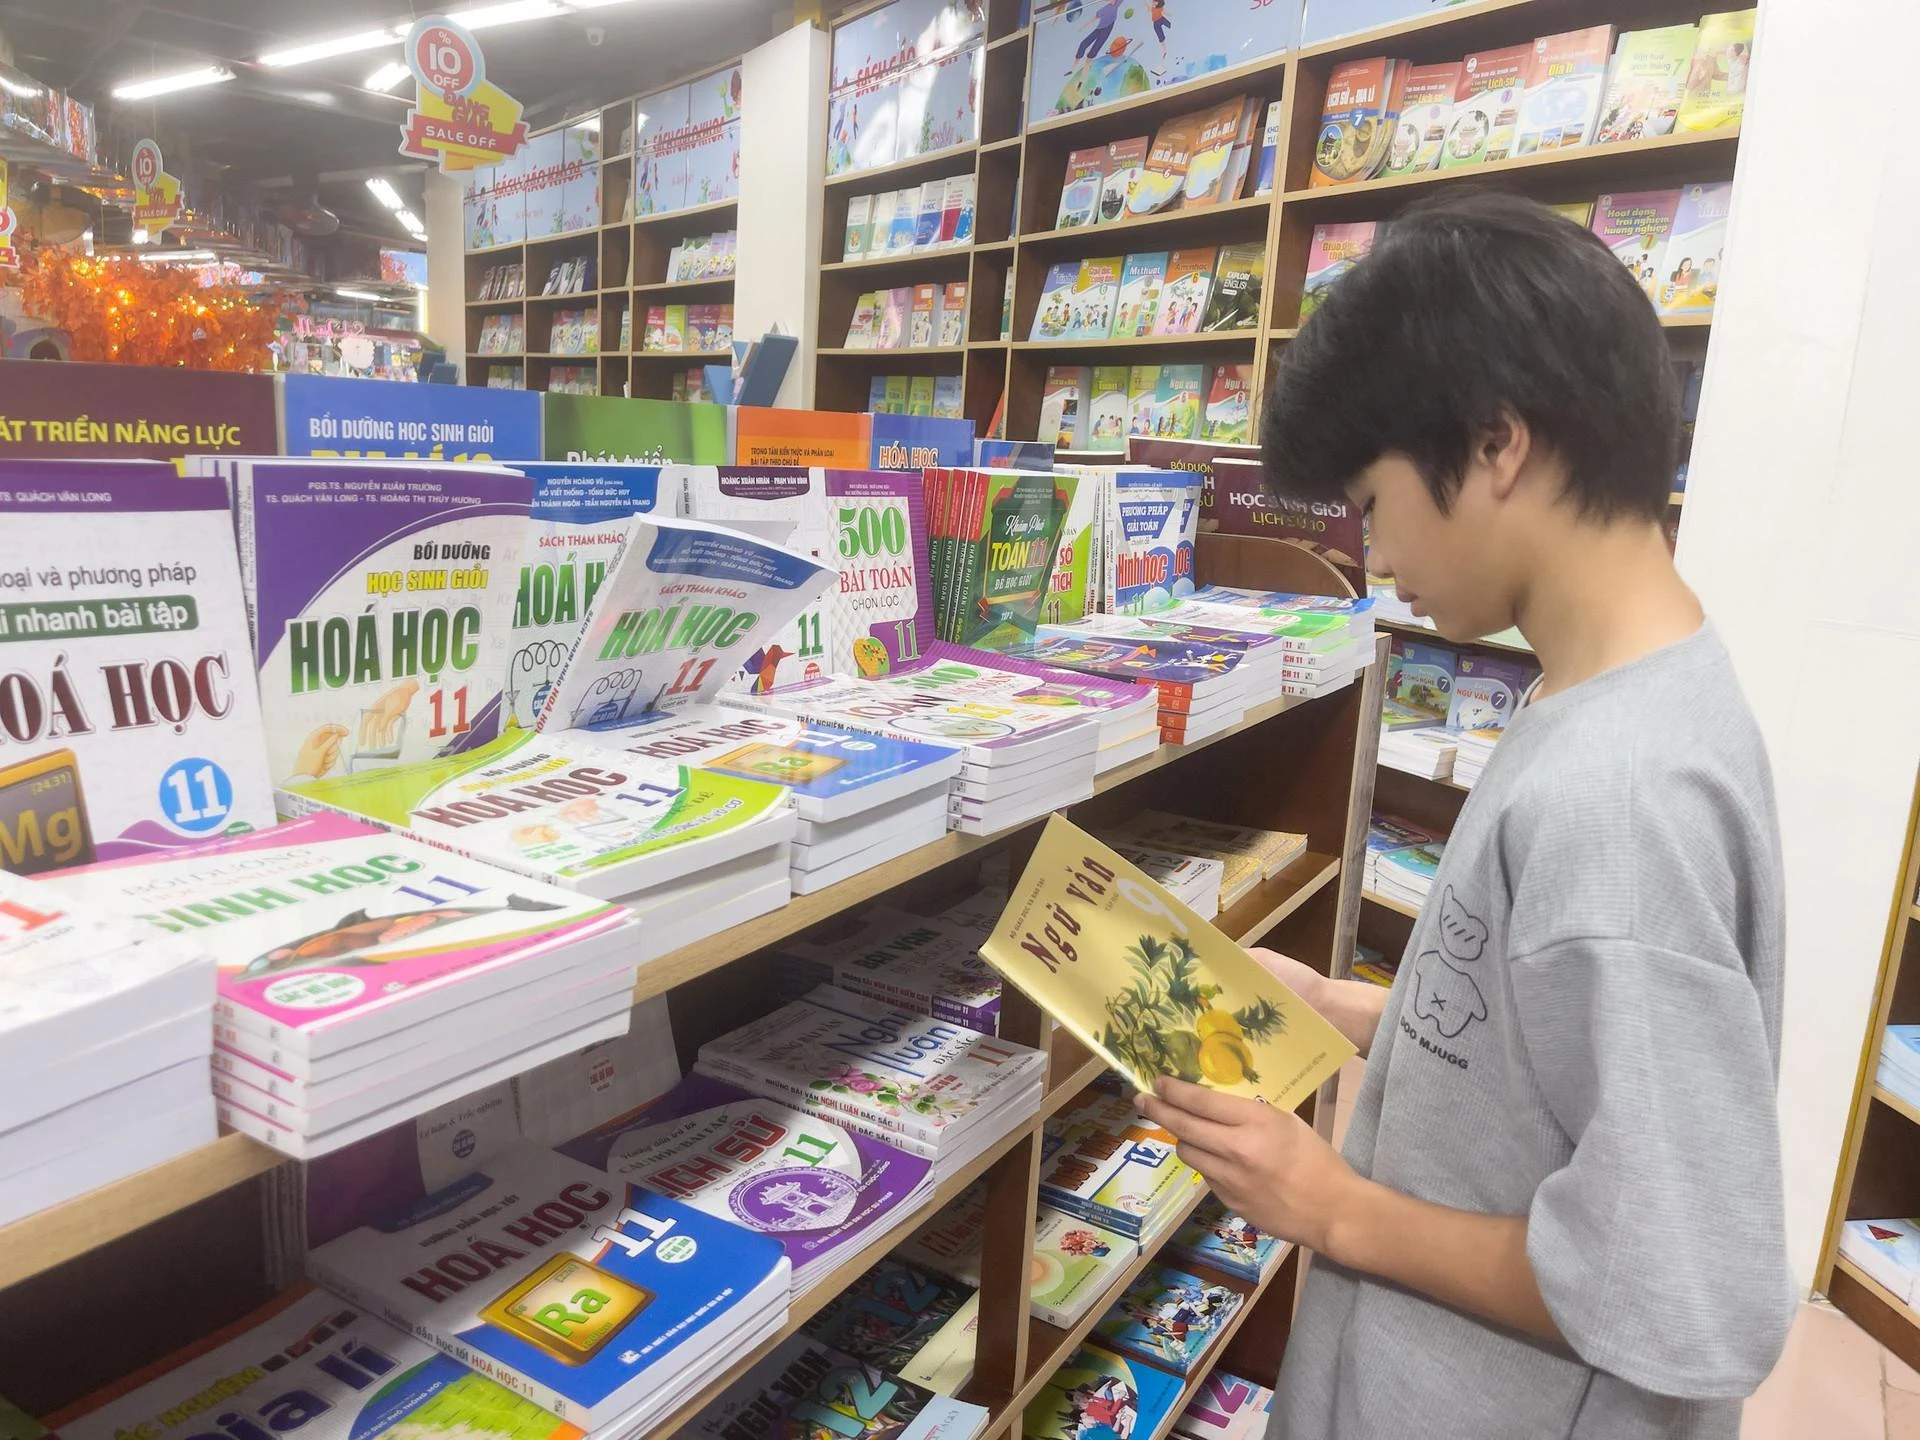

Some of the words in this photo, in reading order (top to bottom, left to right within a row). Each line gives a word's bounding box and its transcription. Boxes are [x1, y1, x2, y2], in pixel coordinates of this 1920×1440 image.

[429, 42, 462, 75] 10
[1671, 58, 1684, 76] 7
[433, 74, 460, 88] OFF
[425, 125, 464, 142] SALE
[468, 134, 497, 148] OFF
[1354, 114, 1363, 126] 7
[140, 157, 151, 170] 10
[1213, 142, 1221, 152] 6
[1191, 272, 1199, 283] 6
[31, 414, 108, 443] TRIỂN
[116, 420, 190, 445] NĂNG
[196, 424, 241, 450] LỰC
[309, 410, 337, 440] BỒI
[341, 417, 394, 441] DƯỠNG
[398, 421, 427, 446] HỌC
[431, 423, 465, 443] SINH
[468, 419, 495, 444] GIỎI
[879, 440, 908, 468] HÓA
[81, 492, 112, 502] LONG
[334, 495, 359, 503] LONG
[1147, 504, 1169, 517] PHÁP
[1229, 492, 1265, 509] HỌC
[838, 504, 907, 560] 500
[1140, 518, 1159, 532] TOÁN
[1252, 511, 1284, 526] LỊCH
[1309, 519, 1327, 533] 10
[414, 541, 438, 561] BỒI
[441, 542, 491, 561] DƯỠNG
[539, 535, 565, 548] SÁCH
[567, 535, 595, 547] THAM
[991, 534, 1029, 573] TOÁN
[1026, 536, 1049, 568] 11
[37, 566, 63, 587] và
[68, 565, 143, 590] phương
[148, 561, 197, 588] pháp
[367, 571, 403, 598] HỌC
[407, 570, 449, 592] SINH
[452, 562, 490, 590] GIỎI
[839, 562, 867, 594] BÀI
[869, 560, 914, 591] TOÁN
[1052, 570, 1073, 593] TÍCH
[1117, 551, 1140, 589] Hình
[1140, 550, 1169, 590] học
[513, 552, 577, 630] HOÁ
[686, 584, 715, 596] THAM
[852, 596, 879, 613] CHỌN
[16, 606, 98, 633] nhanh
[103, 603, 143, 628] bài
[148, 601, 189, 630] tập
[1047, 598, 1061, 625] 11
[595, 596, 685, 662] HOÁ
[669, 602, 759, 652] HỌC
[797, 611, 825, 658] 11
[895, 618, 922, 663] 11
[289, 602, 383, 695] HOÁ
[390, 605, 483, 684] HỌC
[666, 656, 719, 696] 11
[1440, 679, 1448, 690] 7
[100, 653, 233, 735] HỌC
[1494, 693, 1505, 706] 7
[429, 686, 471, 738] 11
[625, 727, 714, 759] HOÁ
[167, 765, 228, 823] 11
[411, 792, 543, 828] HOÁ
[510, 767, 628, 803] HỌC
[615, 782, 687, 807] 11
[0, 805, 82, 866] Mg
[290, 853, 425, 899] HỌC
[393, 875, 490, 908] 11
[1020, 901, 1082, 974] Ngữ
[1064, 855, 1116, 906] văn
[1116, 878, 1189, 936] 9
[933, 1047, 960, 1067] ĐẶC
[967, 1043, 1017, 1067] 11
[1418, 1036, 1470, 1070] MJUGG
[820, 1095, 838, 1112] NGHỊ
[838, 1100, 860, 1117] LUẬN
[860, 1111, 877, 1124] ĐẶC
[877, 1114, 894, 1129] SẮC
[711, 1111, 789, 1165] SỬ
[783, 1132, 839, 1167] 11
[1130, 1142, 1167, 1167] 12
[400, 1236, 530, 1304] HOÁ
[502, 1182, 612, 1248] HỌC
[592, 1207, 679, 1259] 11
[532, 1287, 613, 1338] Ra
[415, 1325, 434, 1342] dẫn
[436, 1333, 454, 1354] học
[455, 1346, 469, 1362] tốt
[496, 1365, 520, 1390] HỌC
[522, 1382, 535, 1398] 11
[789, 1366, 899, 1439] 12
